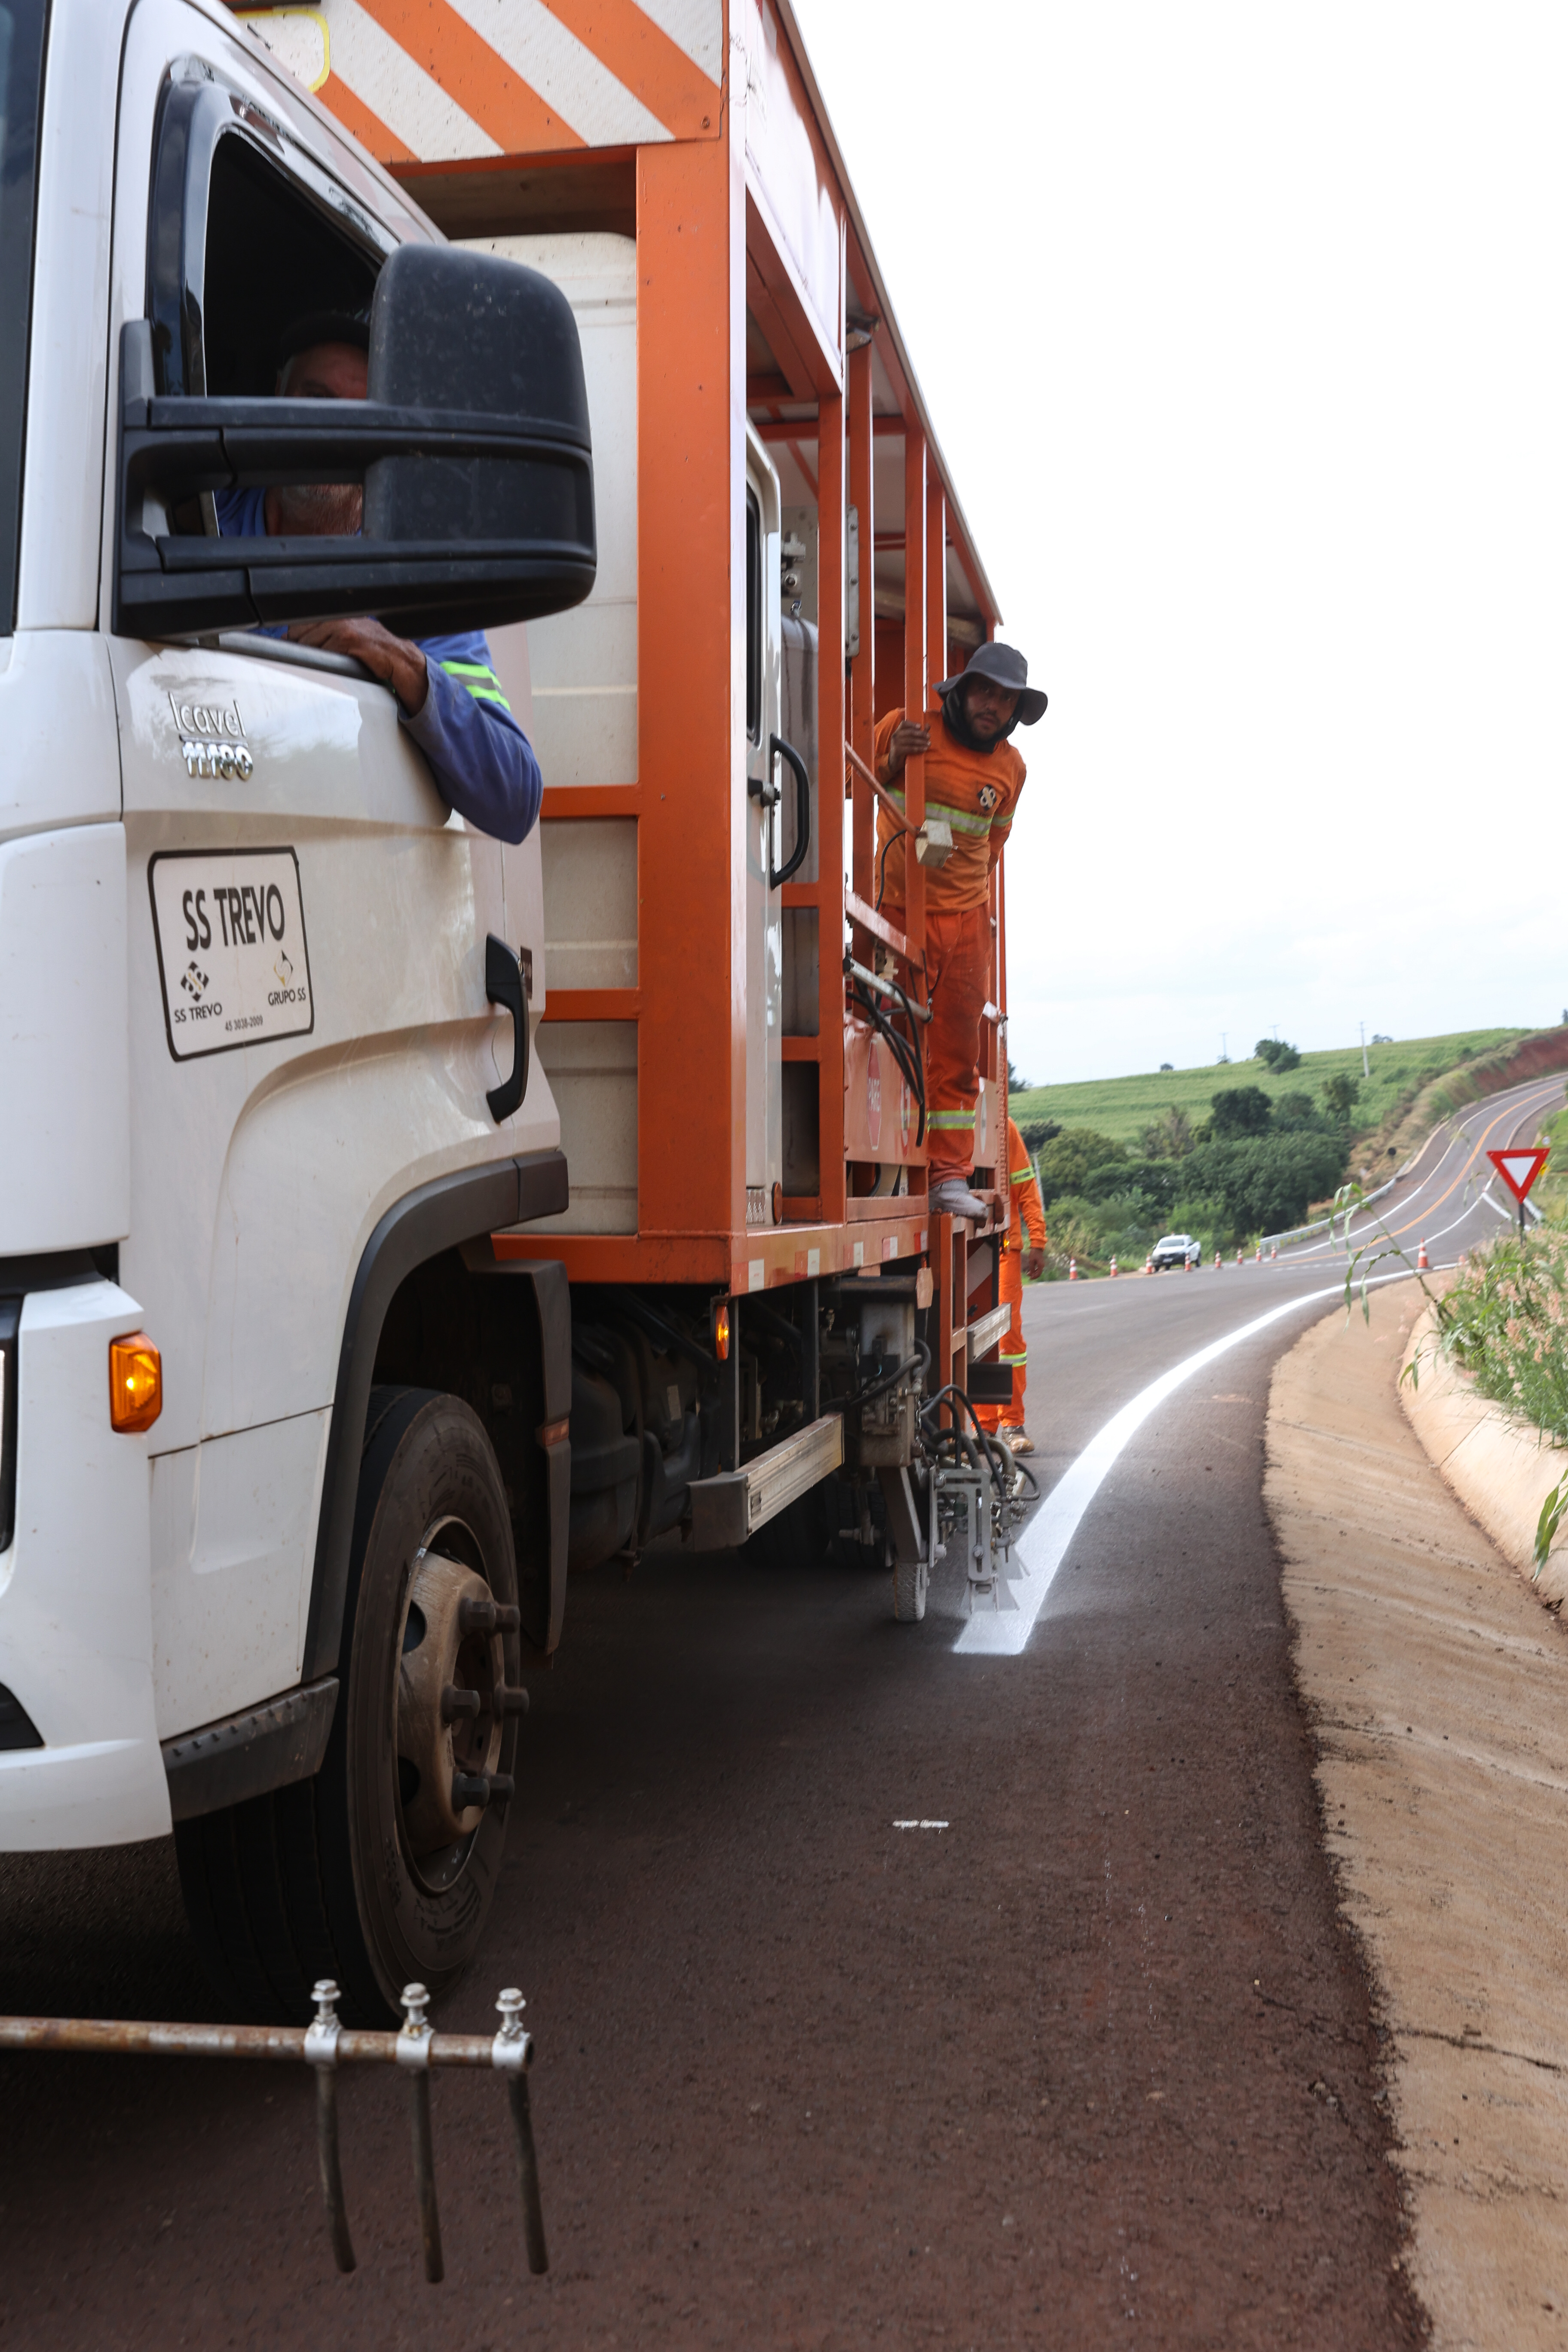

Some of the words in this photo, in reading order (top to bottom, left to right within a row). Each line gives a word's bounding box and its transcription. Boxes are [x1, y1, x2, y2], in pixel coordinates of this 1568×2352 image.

[183, 889, 212, 952] SS
[213, 883, 285, 947] TREVO
[268, 988, 296, 1006] GRUPO
[297, 987, 306, 1001] SS
[175, 1009, 187, 1023] SS
[189, 1002, 223, 1020] TREVO
